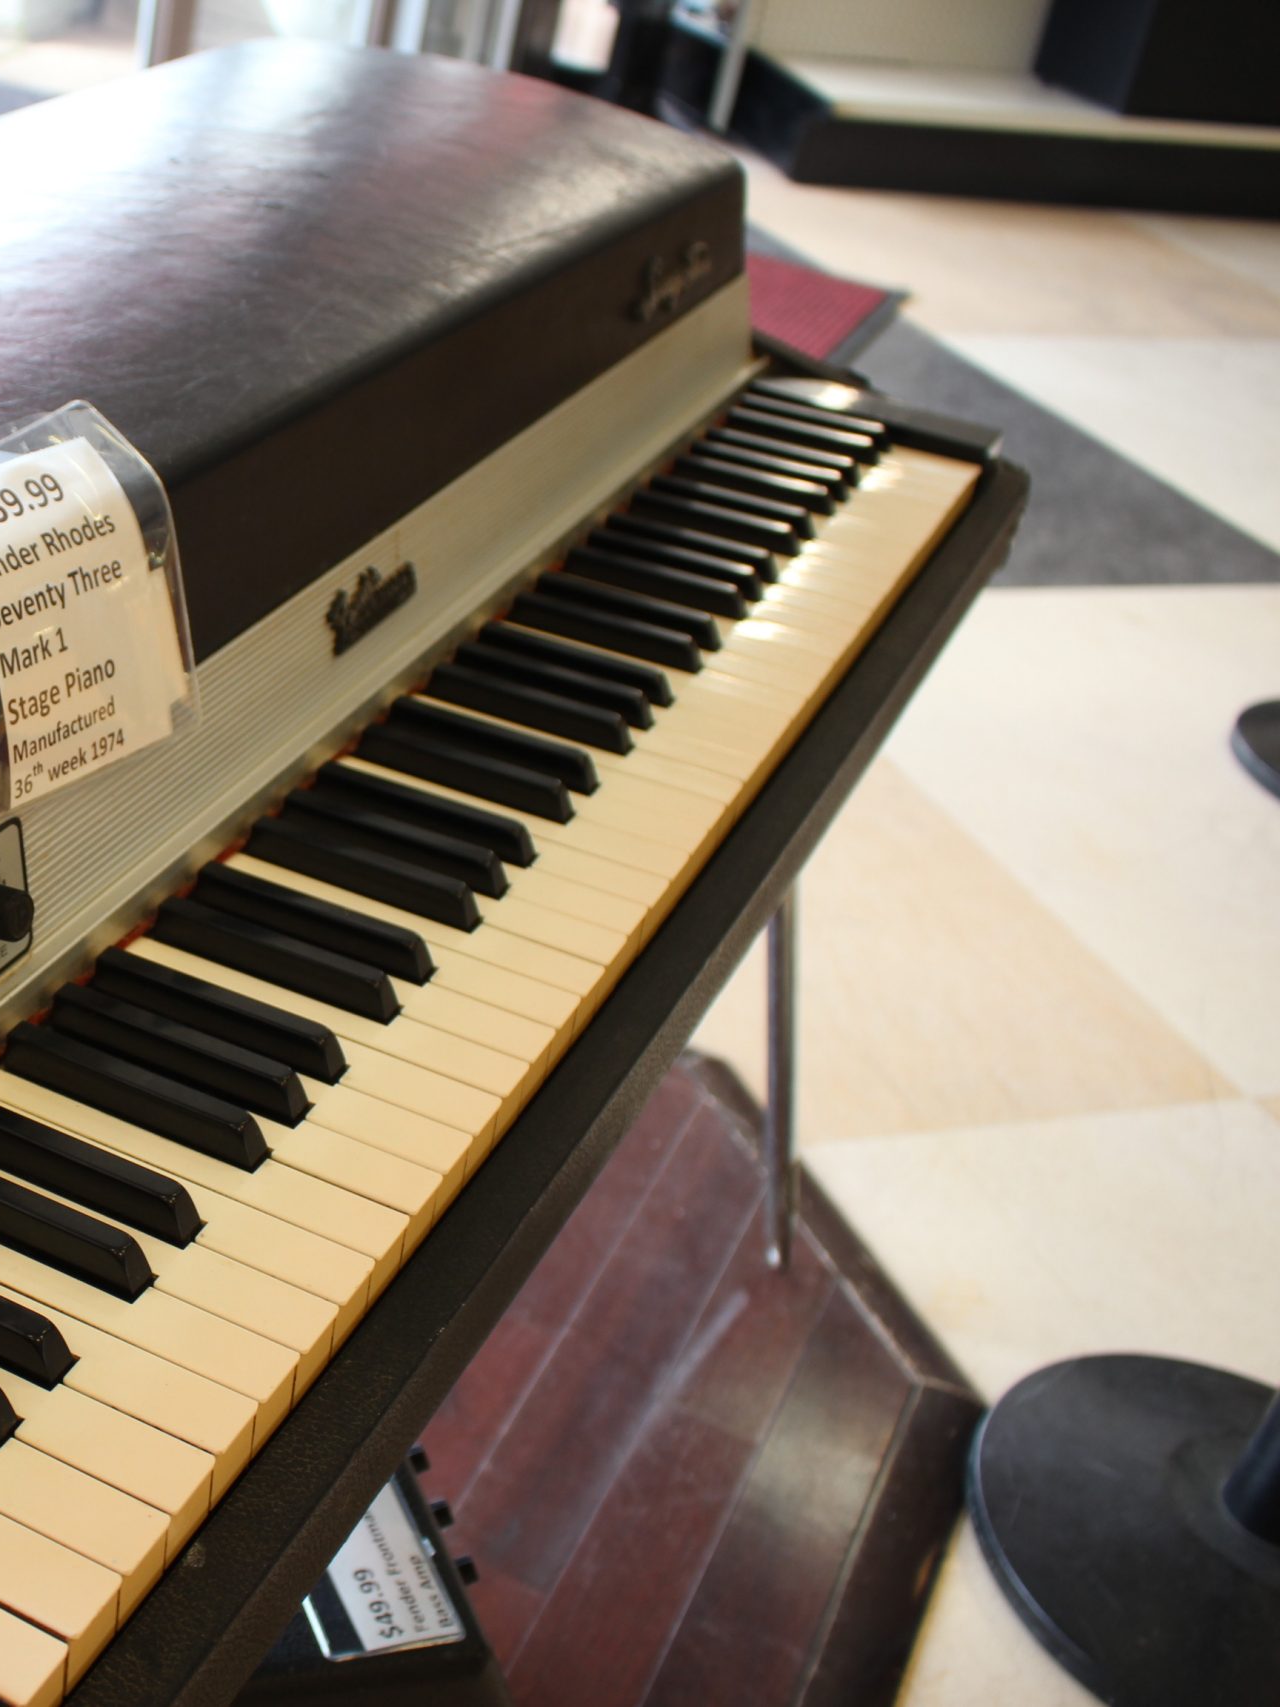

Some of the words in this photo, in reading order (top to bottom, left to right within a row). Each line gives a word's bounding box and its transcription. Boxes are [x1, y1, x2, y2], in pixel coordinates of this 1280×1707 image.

[40, 514, 116, 556] Rhodes
[67, 560, 123, 596] Three
[0, 634, 52, 678] Mark
[55, 627, 68, 653] 1
[8, 685, 61, 725] Stage
[65, 659, 116, 698] Piano
[13, 694, 116, 764] Manufactured
[14, 761, 44, 799] 36th
[48, 747, 88, 782] week
[91, 728, 125, 760] 1974
[409, 1554, 436, 1591] Amp
[352, 1567, 405, 1640] $49.99
[395, 1580, 430, 1633] Fender
[428, 1595, 454, 1629] Bass
